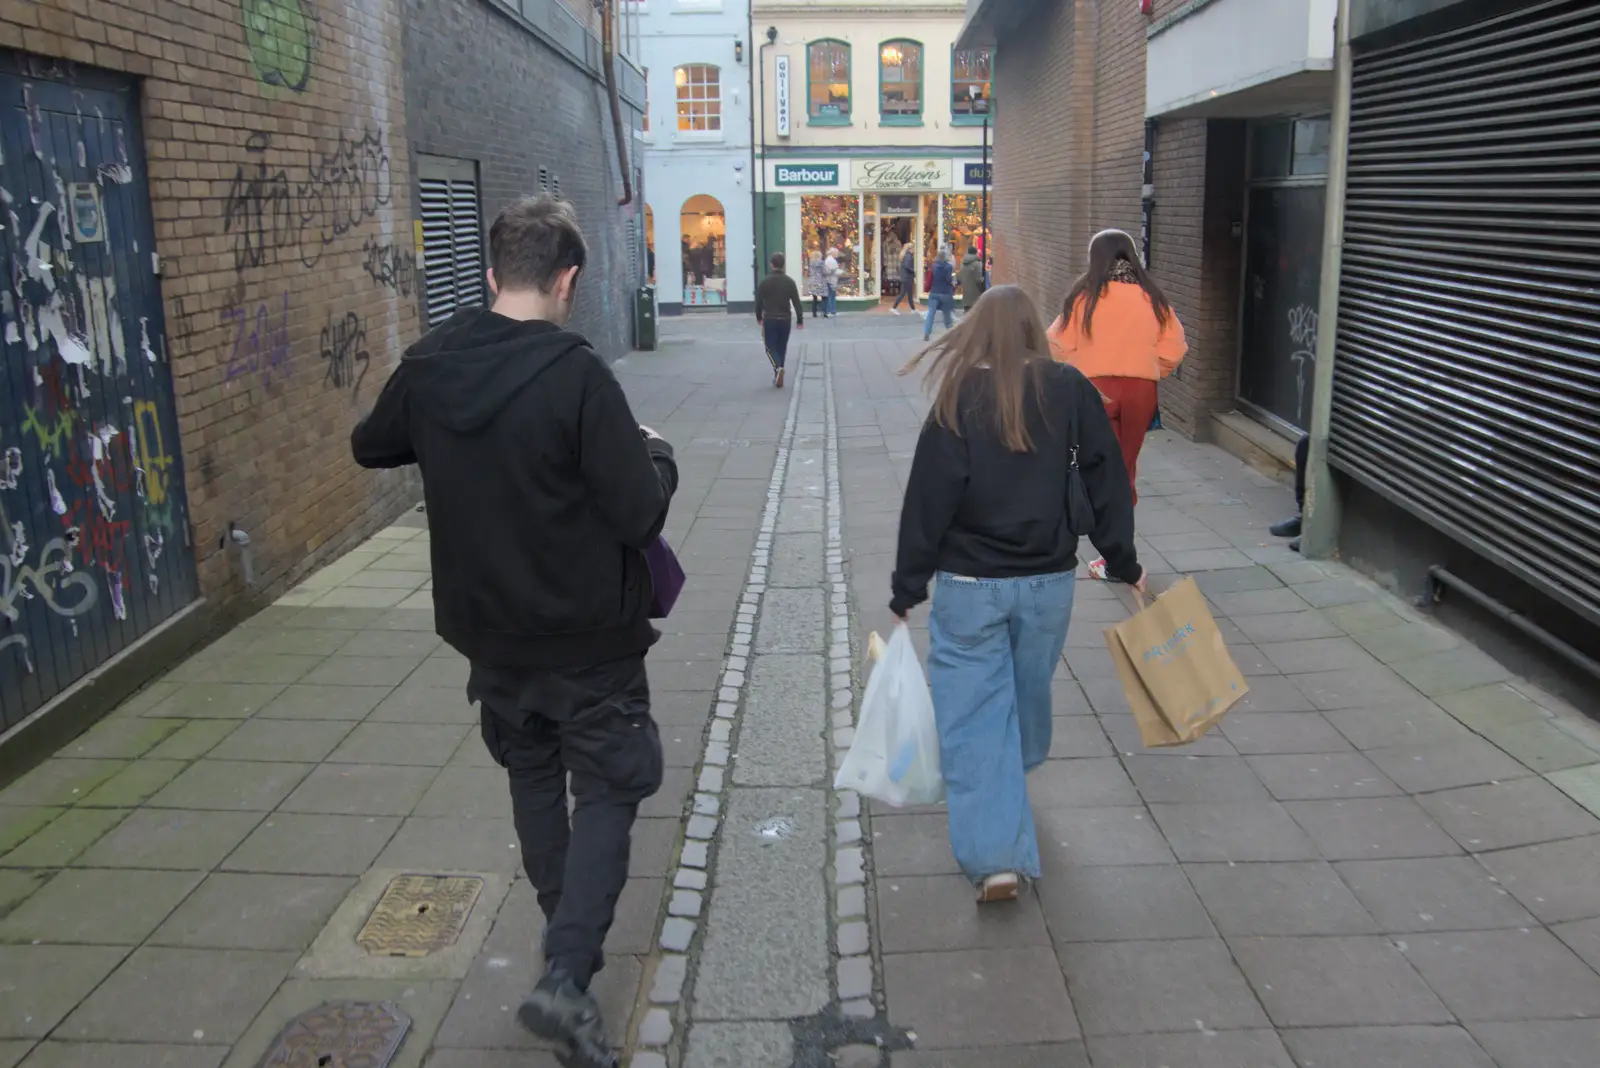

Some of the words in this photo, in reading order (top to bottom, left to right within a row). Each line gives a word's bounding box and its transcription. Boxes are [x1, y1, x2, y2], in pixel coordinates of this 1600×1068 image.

[778, 62, 787, 130] Gallyons
[778, 168, 836, 182] Barbour
[857, 161, 945, 188] Gallyons
